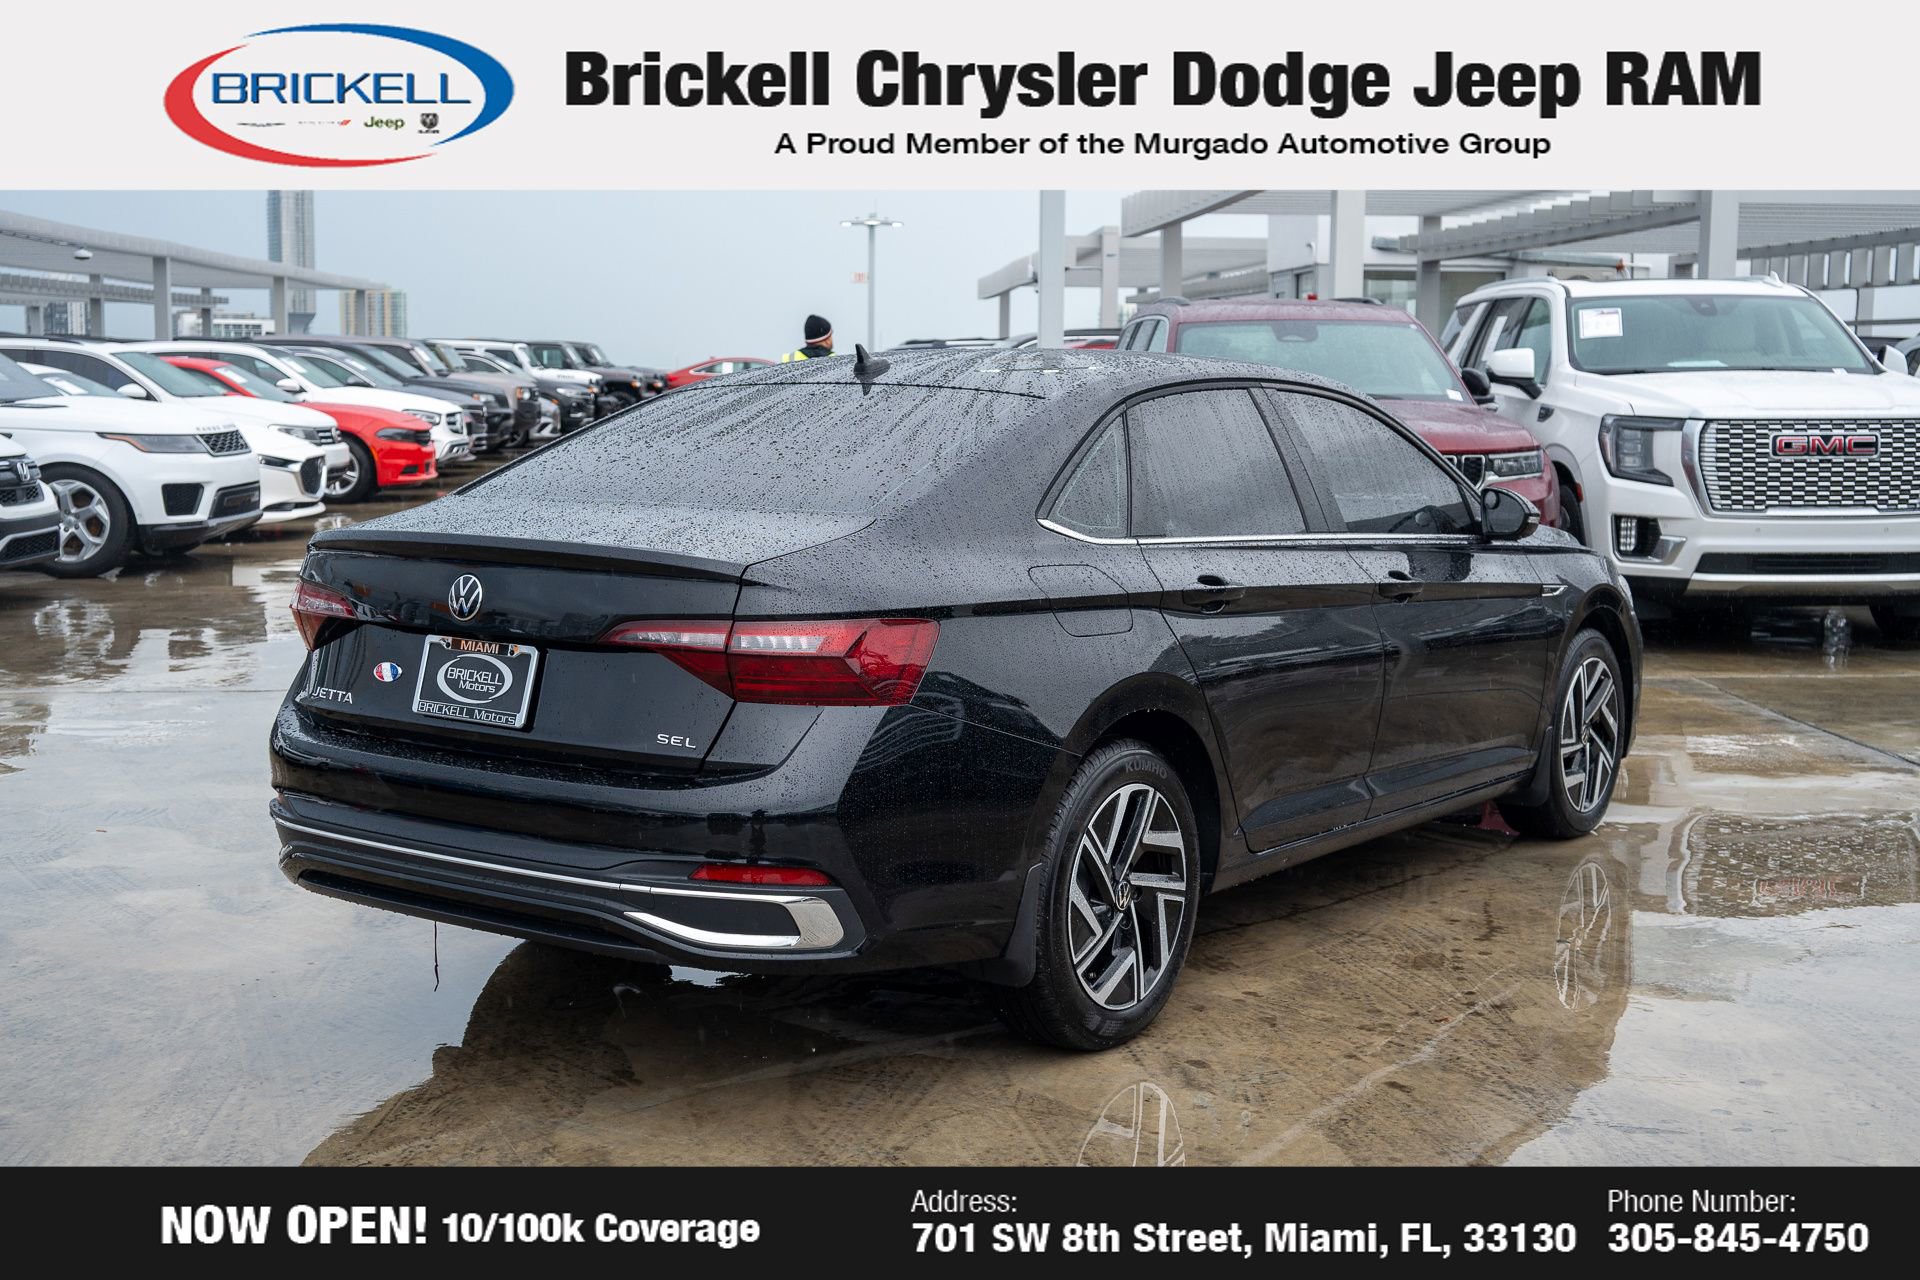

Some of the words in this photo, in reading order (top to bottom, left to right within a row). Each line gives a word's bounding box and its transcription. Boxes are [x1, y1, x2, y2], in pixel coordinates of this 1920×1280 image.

[1776, 435, 1876, 455] GMC
[460, 640, 500, 654] MIAMI
[447, 667, 503, 685] BRICKELL
[312, 686, 353, 705] JETTA
[458, 680, 496, 693] Motors
[418, 702, 470, 718] BRICKELL
[473, 709, 516, 724] Motors
[656, 733, 697, 749] SEL
[1125, 760, 1168, 779] KUMHO
